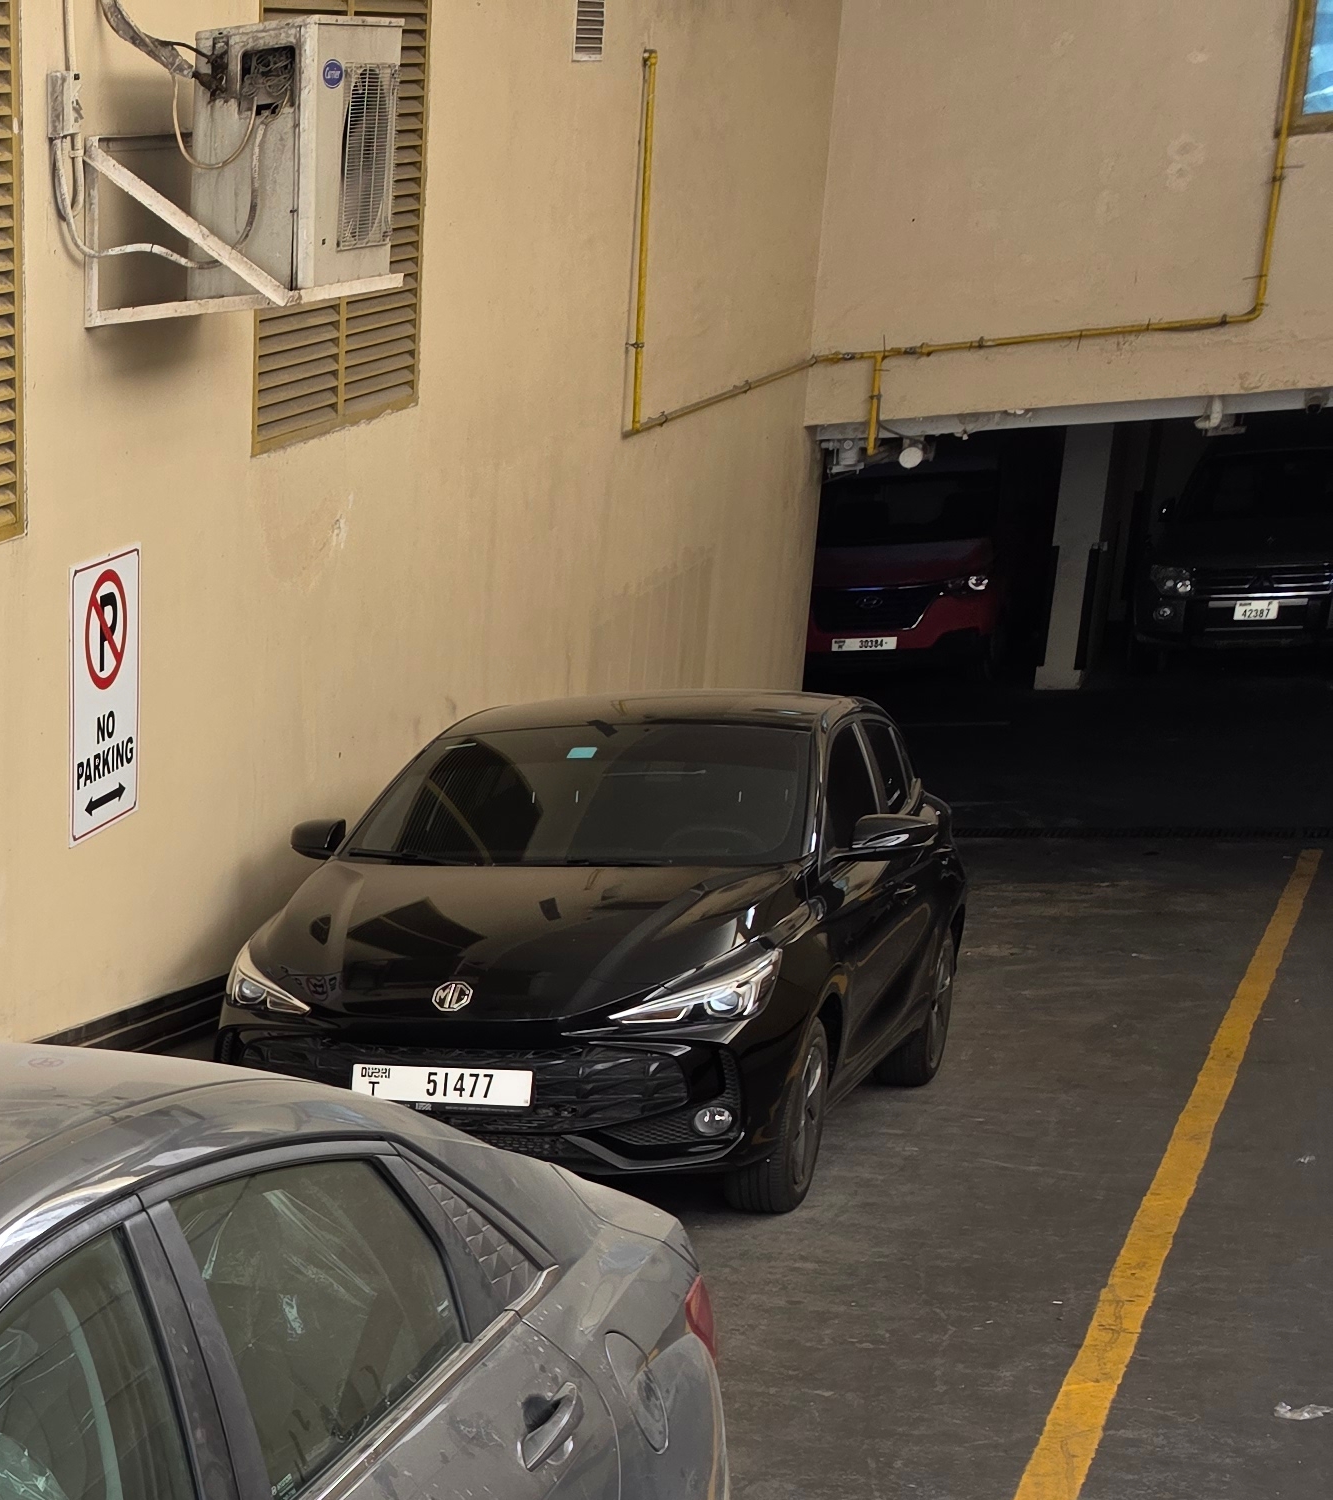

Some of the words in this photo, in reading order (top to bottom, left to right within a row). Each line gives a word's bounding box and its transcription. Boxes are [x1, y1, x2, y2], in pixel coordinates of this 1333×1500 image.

[1241, 608, 1271, 618] 42387
[99, 591, 118, 672] P
[859, 639, 884, 649] 30384
[96, 710, 115, 744] NO
[76, 737, 134, 790] PARKING
[435, 982, 472, 1010] MG
[368, 1081, 380, 1096] T
[425, 1071, 494, 1098] 51477
